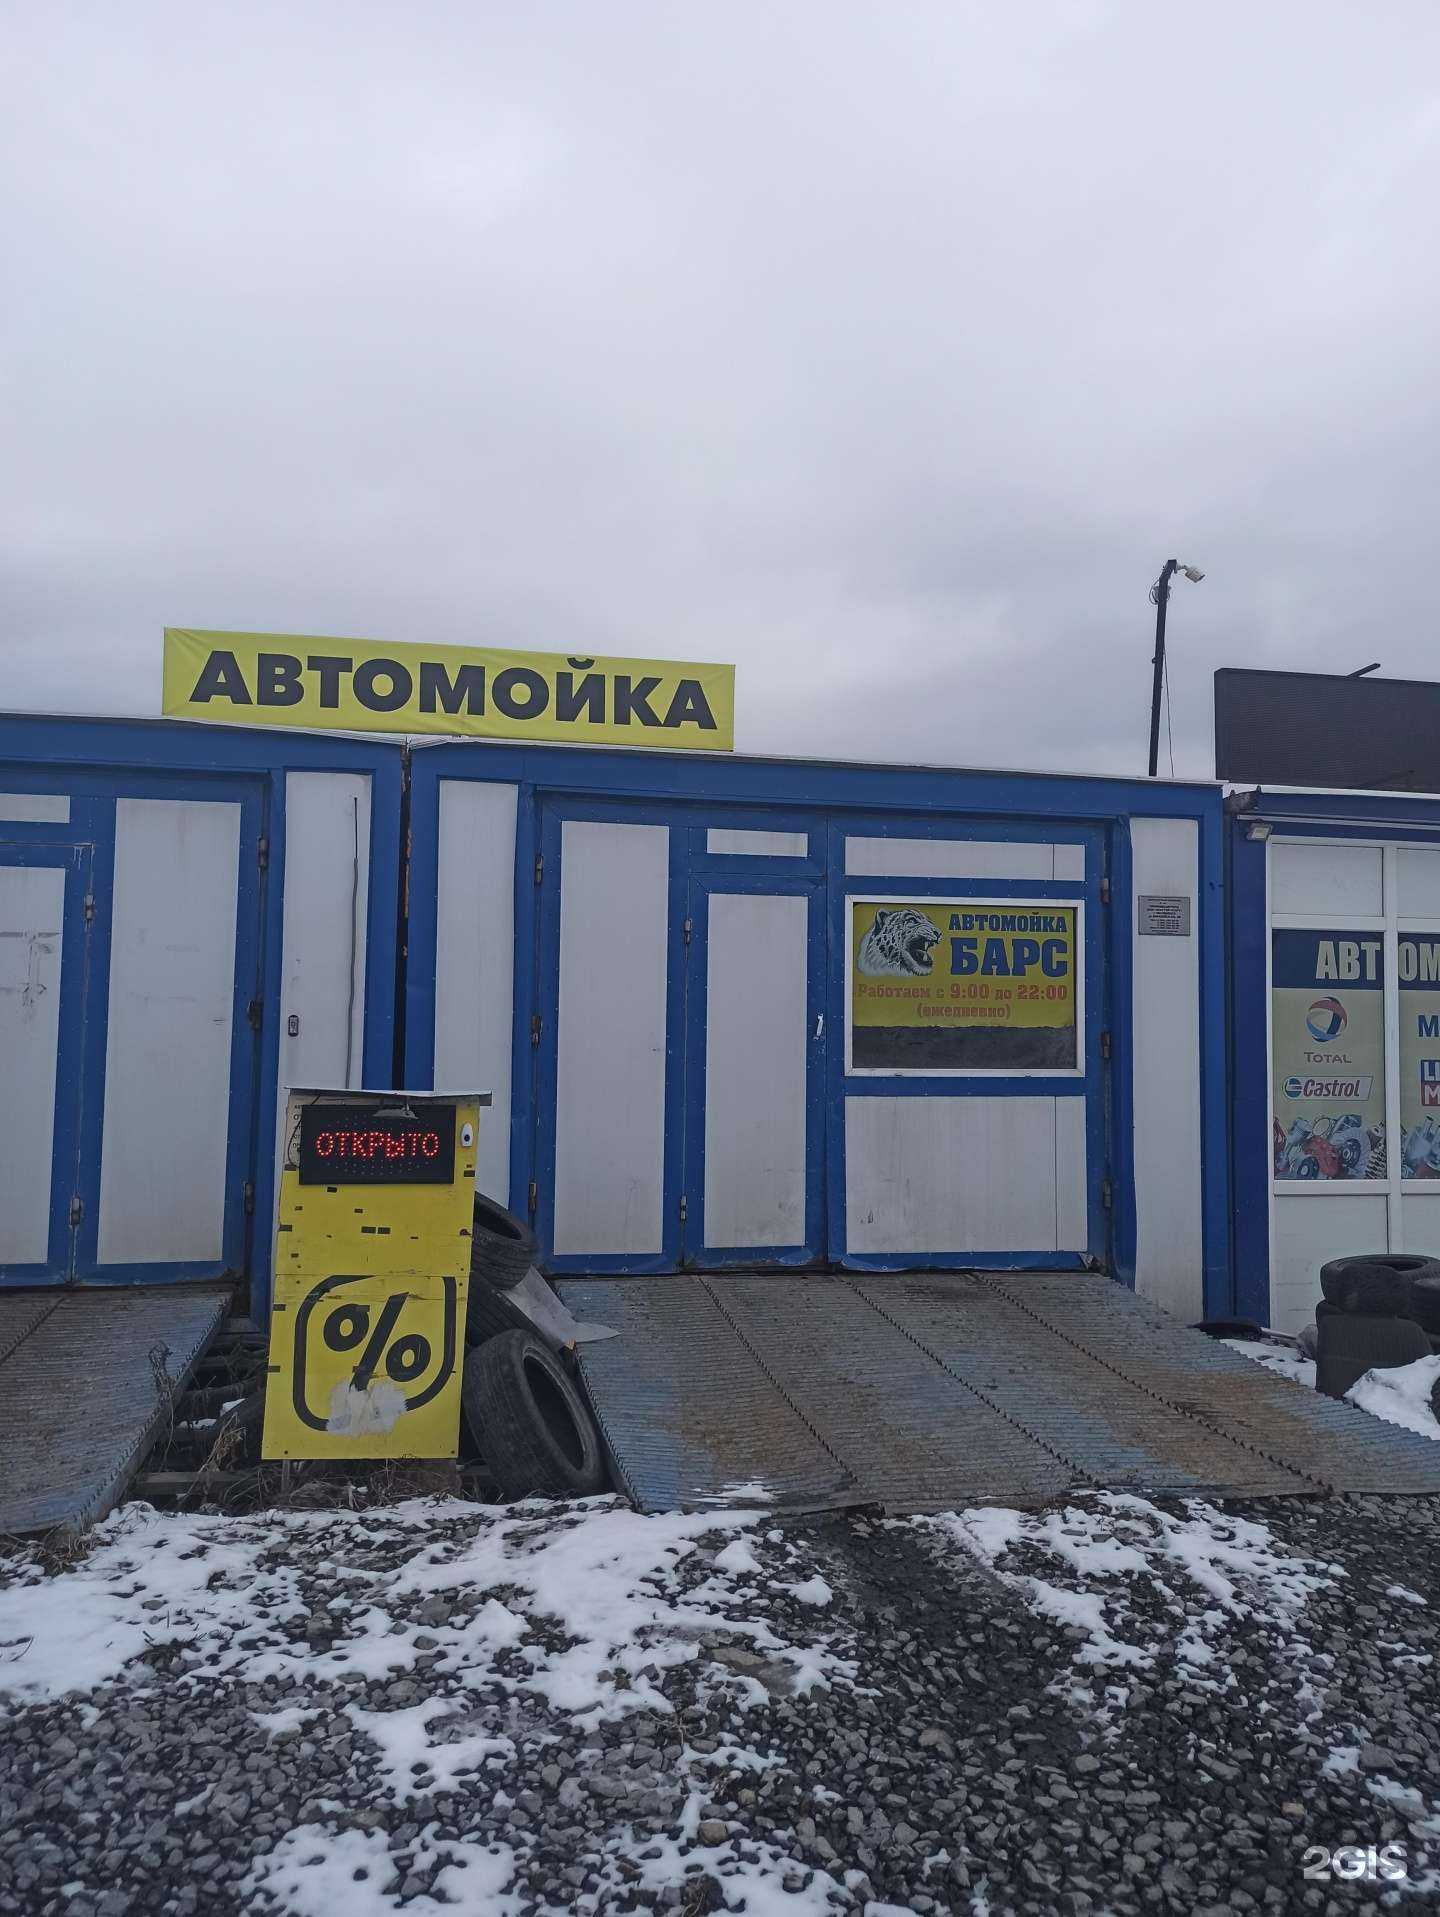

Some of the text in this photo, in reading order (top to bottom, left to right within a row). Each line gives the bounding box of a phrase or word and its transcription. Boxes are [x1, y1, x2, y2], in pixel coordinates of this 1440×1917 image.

[188, 649, 718, 730] АВТОМОЙКА
[949, 911, 1067, 932] АВТОМОЙКА
[949, 937, 1068, 977] БАРС
[858, 983, 930, 999] Работаем
[950, 983, 990, 999] 9:00
[994, 988, 1012, 1000] до
[1017, 984, 1067, 1000] 22:00
[1303, 1079, 1360, 1098] Castrol
[315, 1131, 440, 1157] ОТКРЫТО
